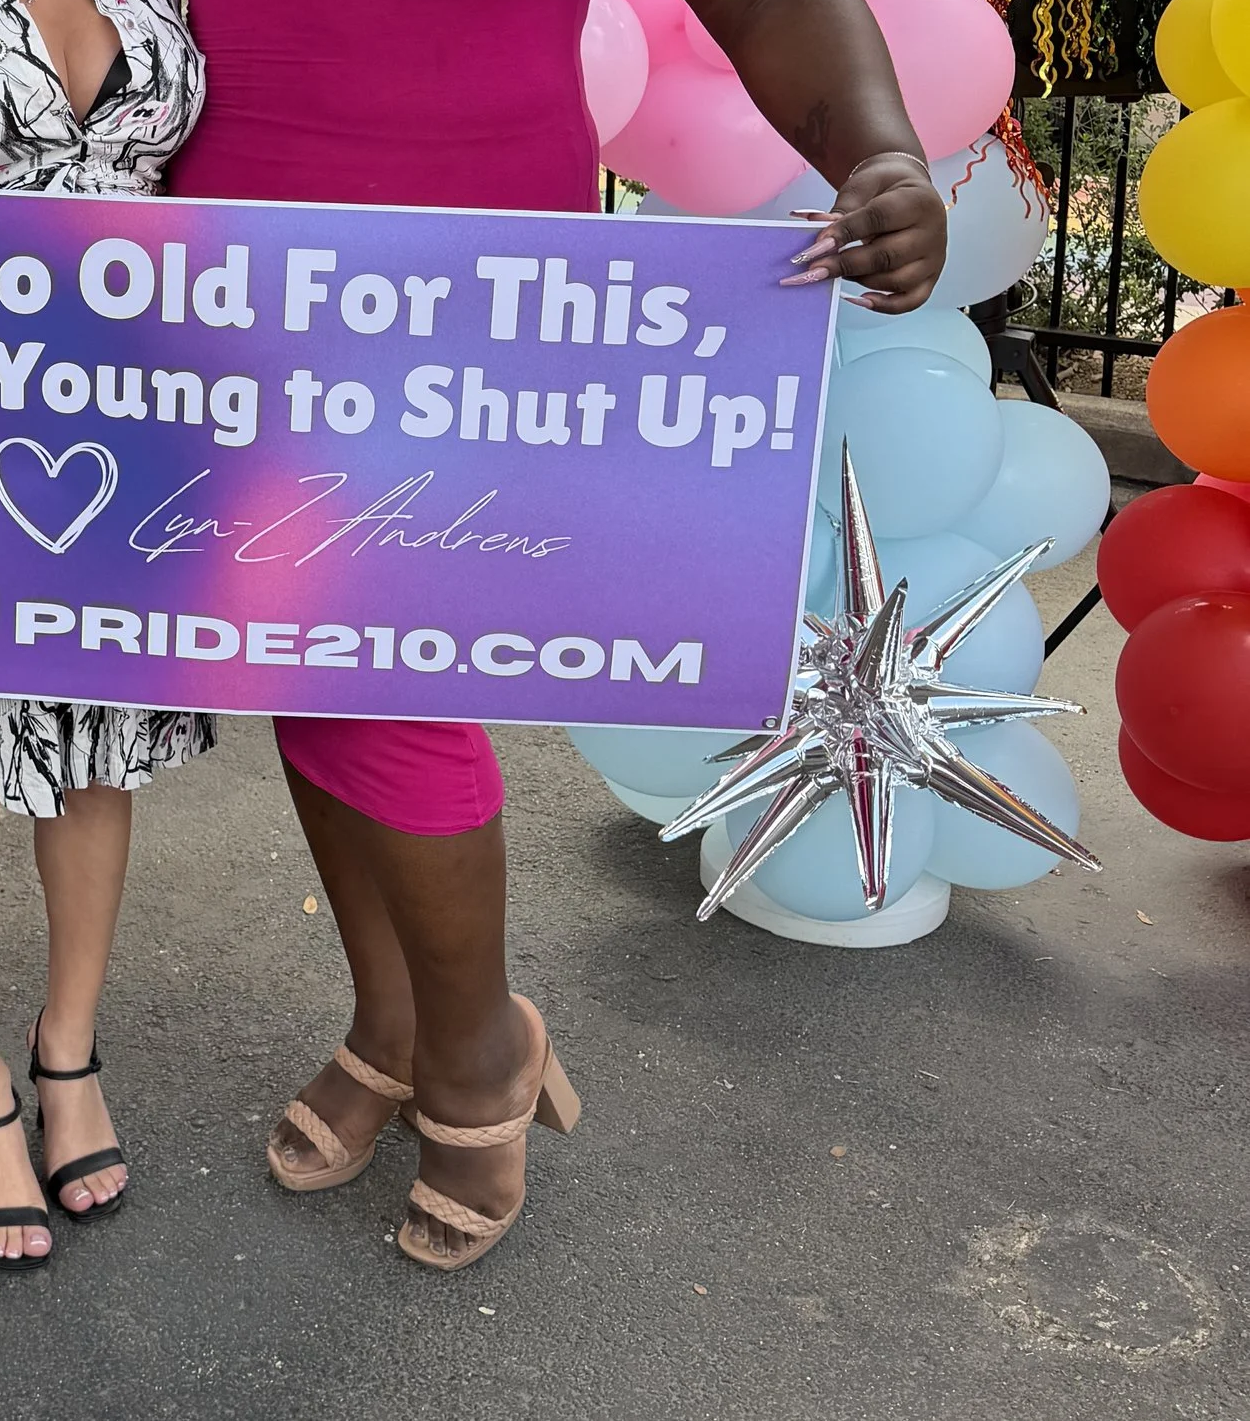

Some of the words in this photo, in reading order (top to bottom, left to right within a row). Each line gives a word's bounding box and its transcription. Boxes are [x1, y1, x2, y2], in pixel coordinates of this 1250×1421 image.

[79, 237, 255, 329] Old
[283, 248, 452, 337] For
[475, 255, 728, 359] This,
[284, 369, 377, 435] to
[399, 364, 617, 447] Shut
[637, 374, 800, 468] Up!
[15, 600, 704, 685] PRIDE210.COM
